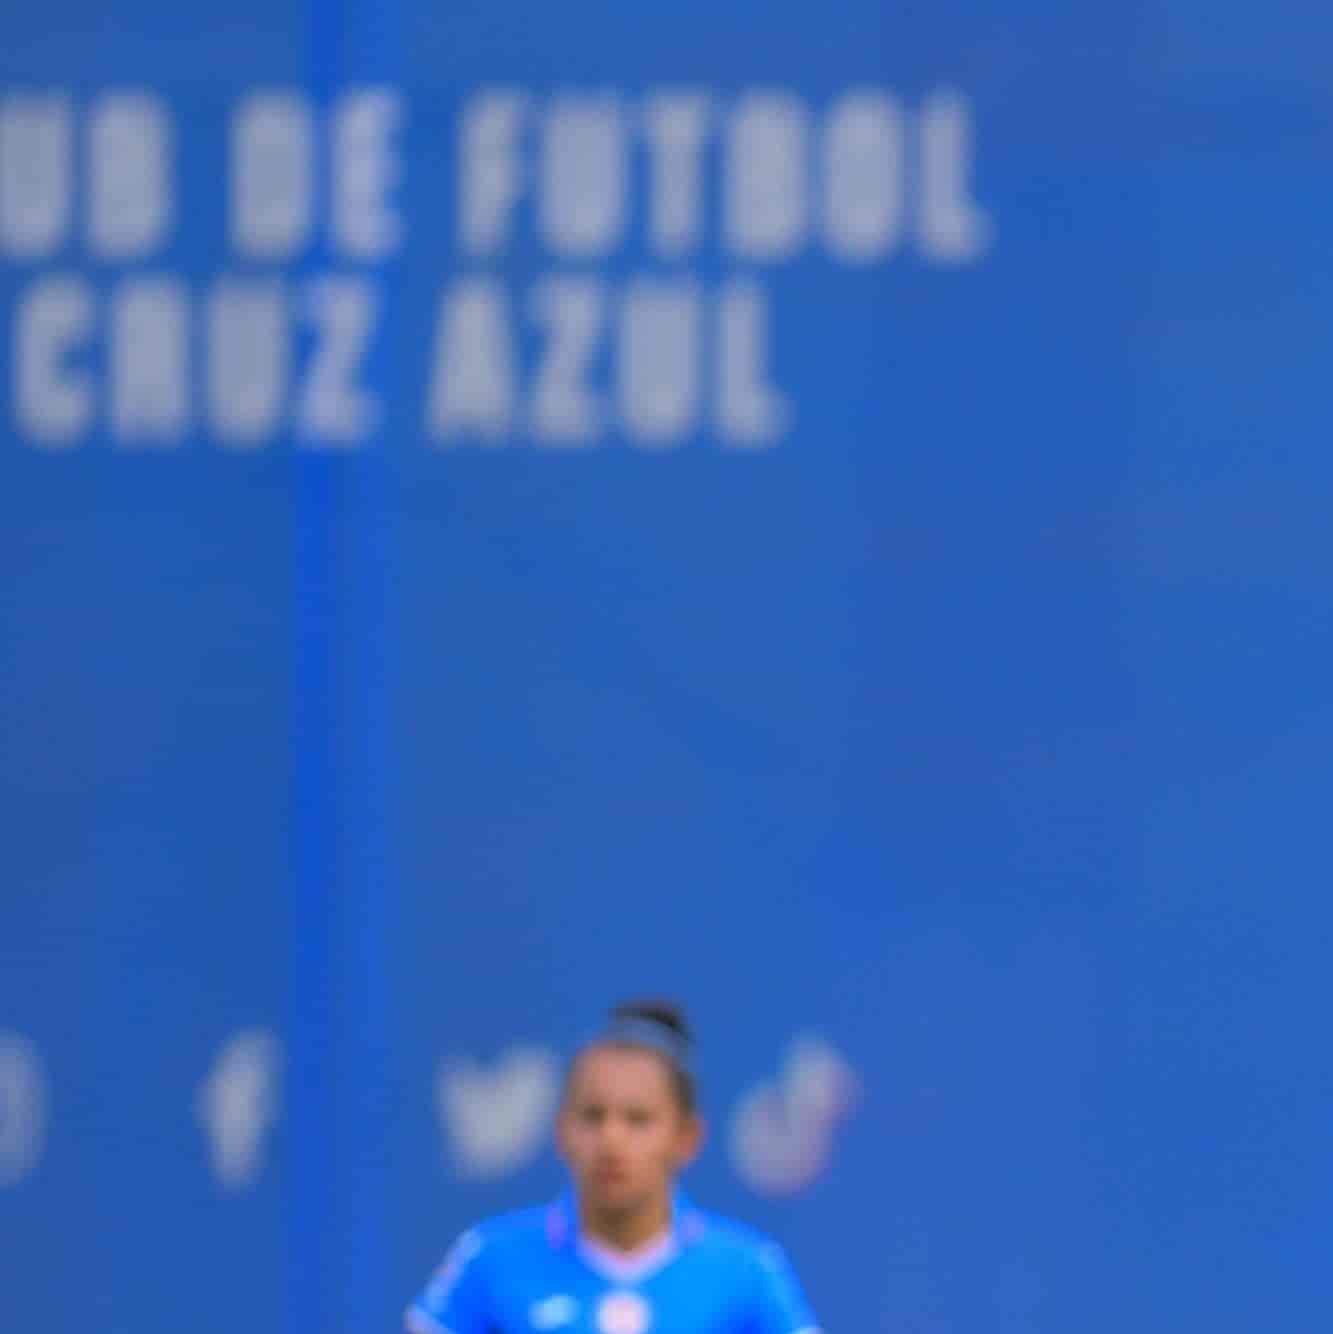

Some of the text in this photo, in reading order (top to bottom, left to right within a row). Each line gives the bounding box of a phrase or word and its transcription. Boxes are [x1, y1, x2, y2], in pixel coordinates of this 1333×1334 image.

[228, 88, 405, 264] DE
[457, 86, 990, 266] FUTBOL
[12, 274, 790, 450] CRUZ AZUL
